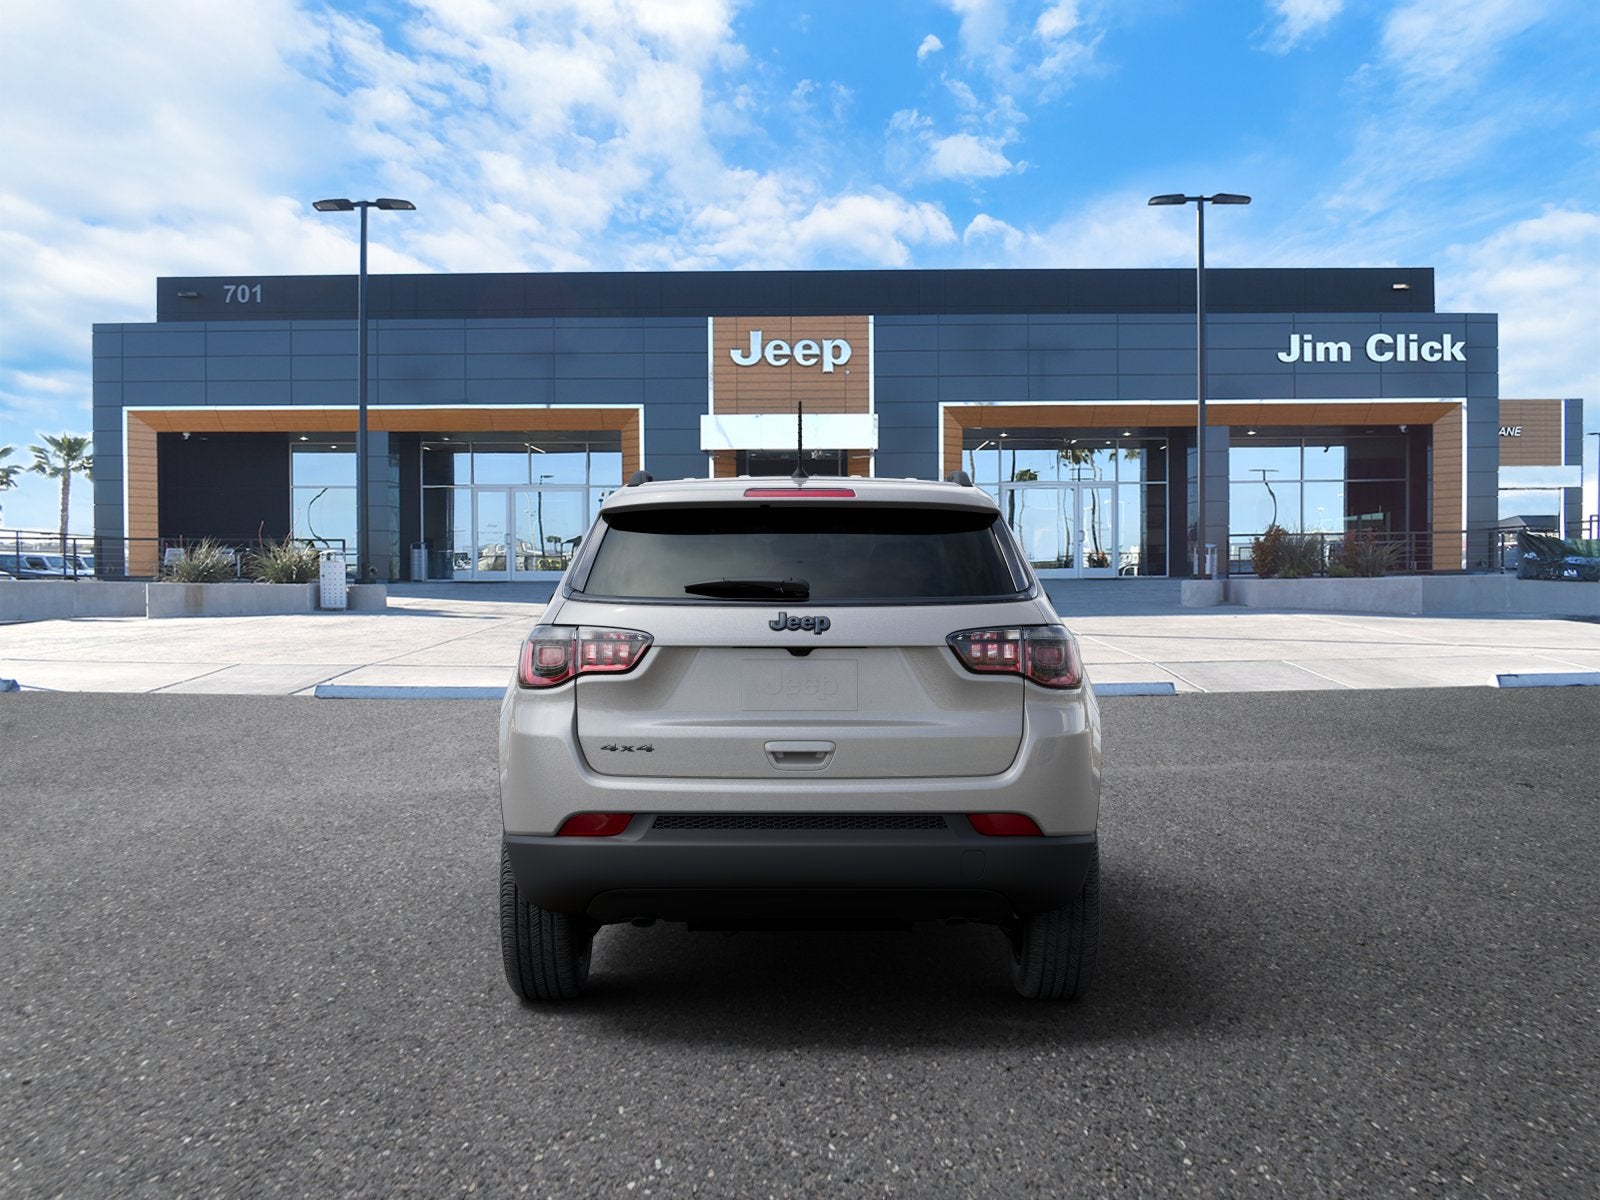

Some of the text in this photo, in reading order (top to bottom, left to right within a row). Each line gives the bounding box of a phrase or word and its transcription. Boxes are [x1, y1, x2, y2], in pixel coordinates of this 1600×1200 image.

[223, 284, 262, 304] 701
[729, 330, 852, 374] Jeep
[1277, 333, 1467, 363] Jim Click
[768, 611, 831, 635] Jeep
[762, 670, 840, 701] Jeep
